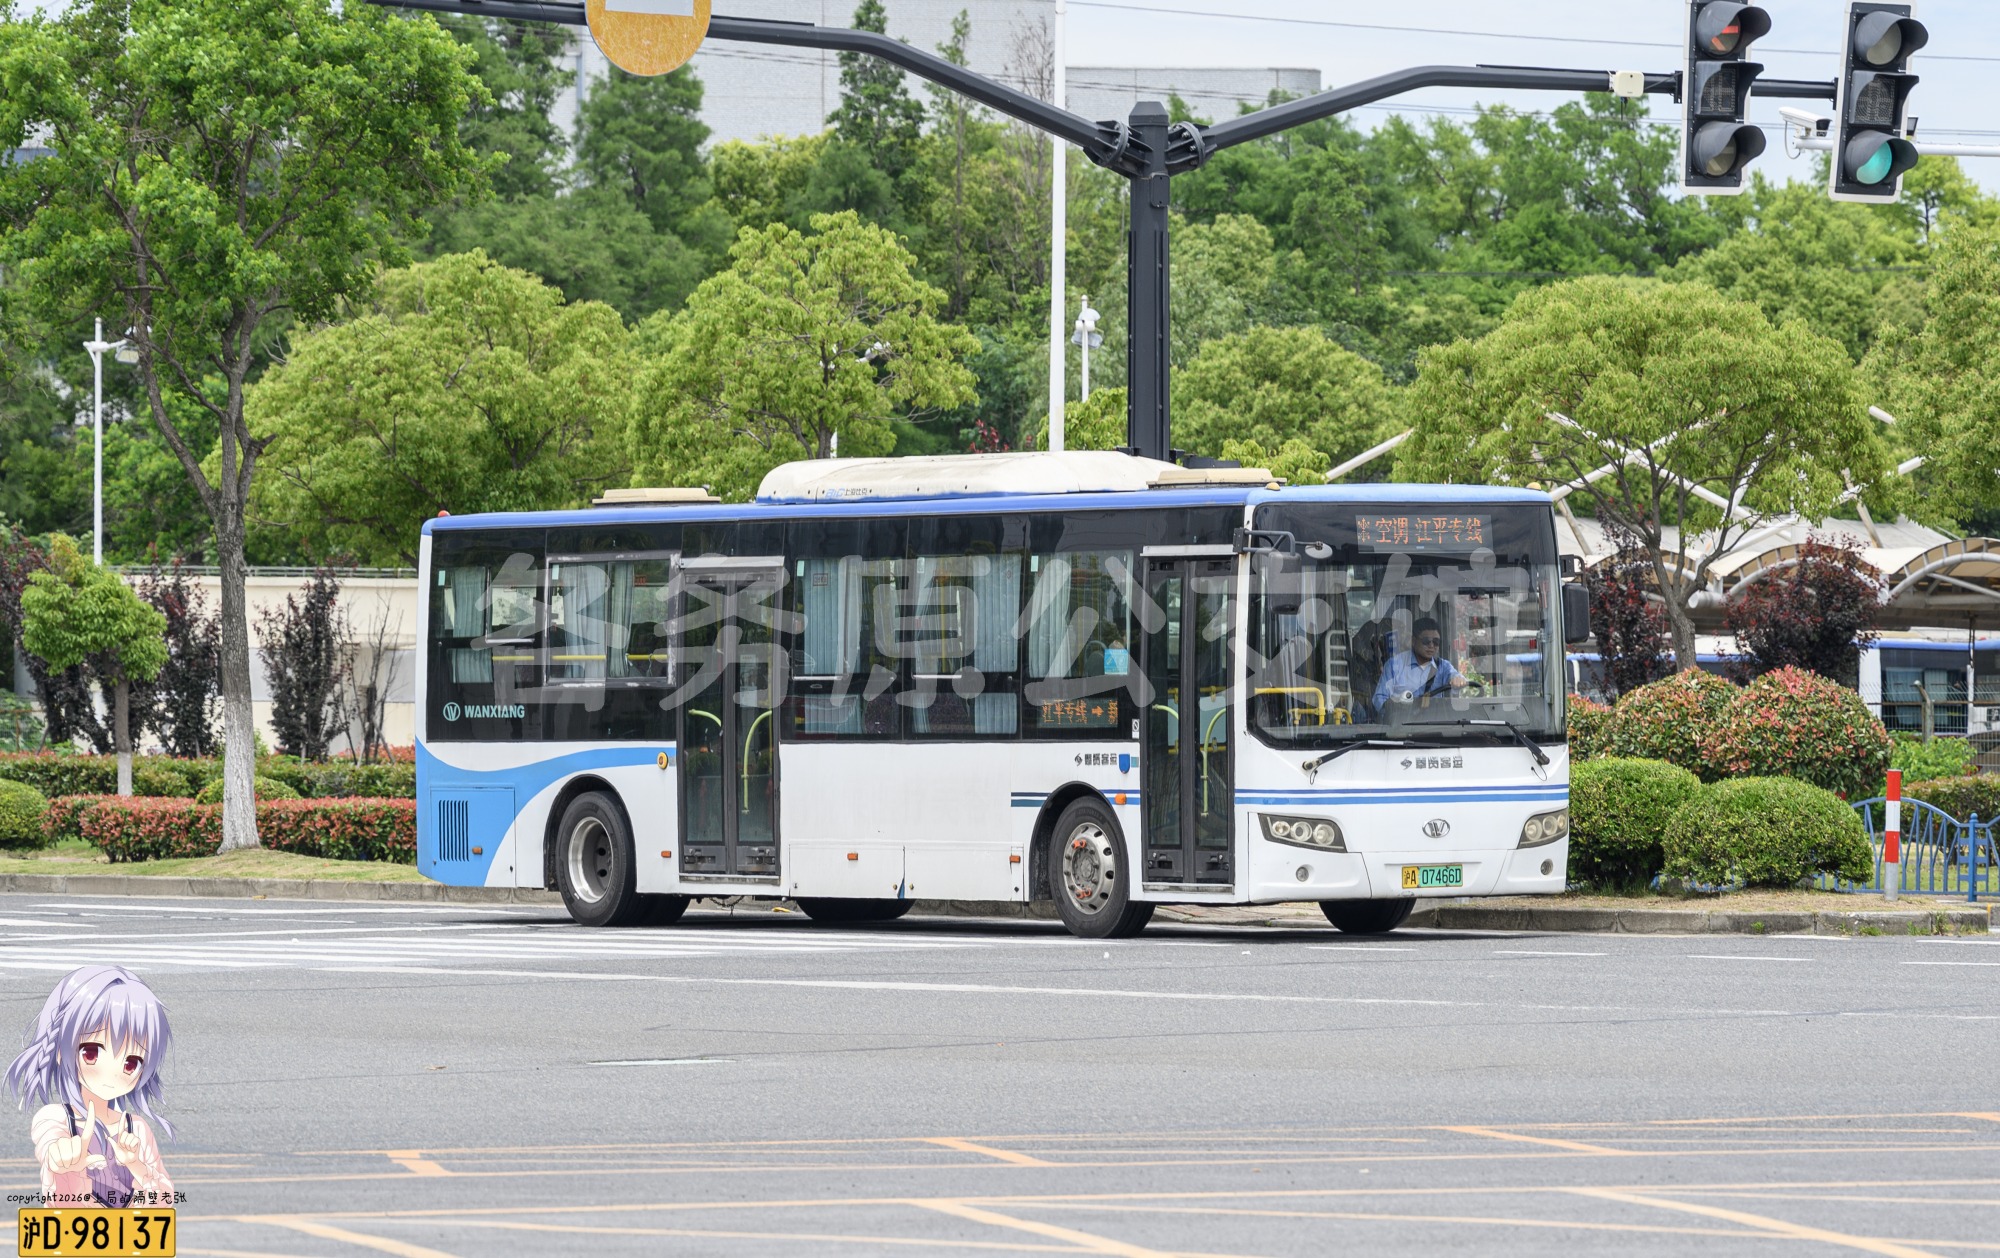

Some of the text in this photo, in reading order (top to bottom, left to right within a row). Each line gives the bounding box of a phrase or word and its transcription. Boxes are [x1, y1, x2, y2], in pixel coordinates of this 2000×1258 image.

[1376, 517, 1483, 544] 空调 江平专线
[464, 705, 525, 718] WANXIANG
